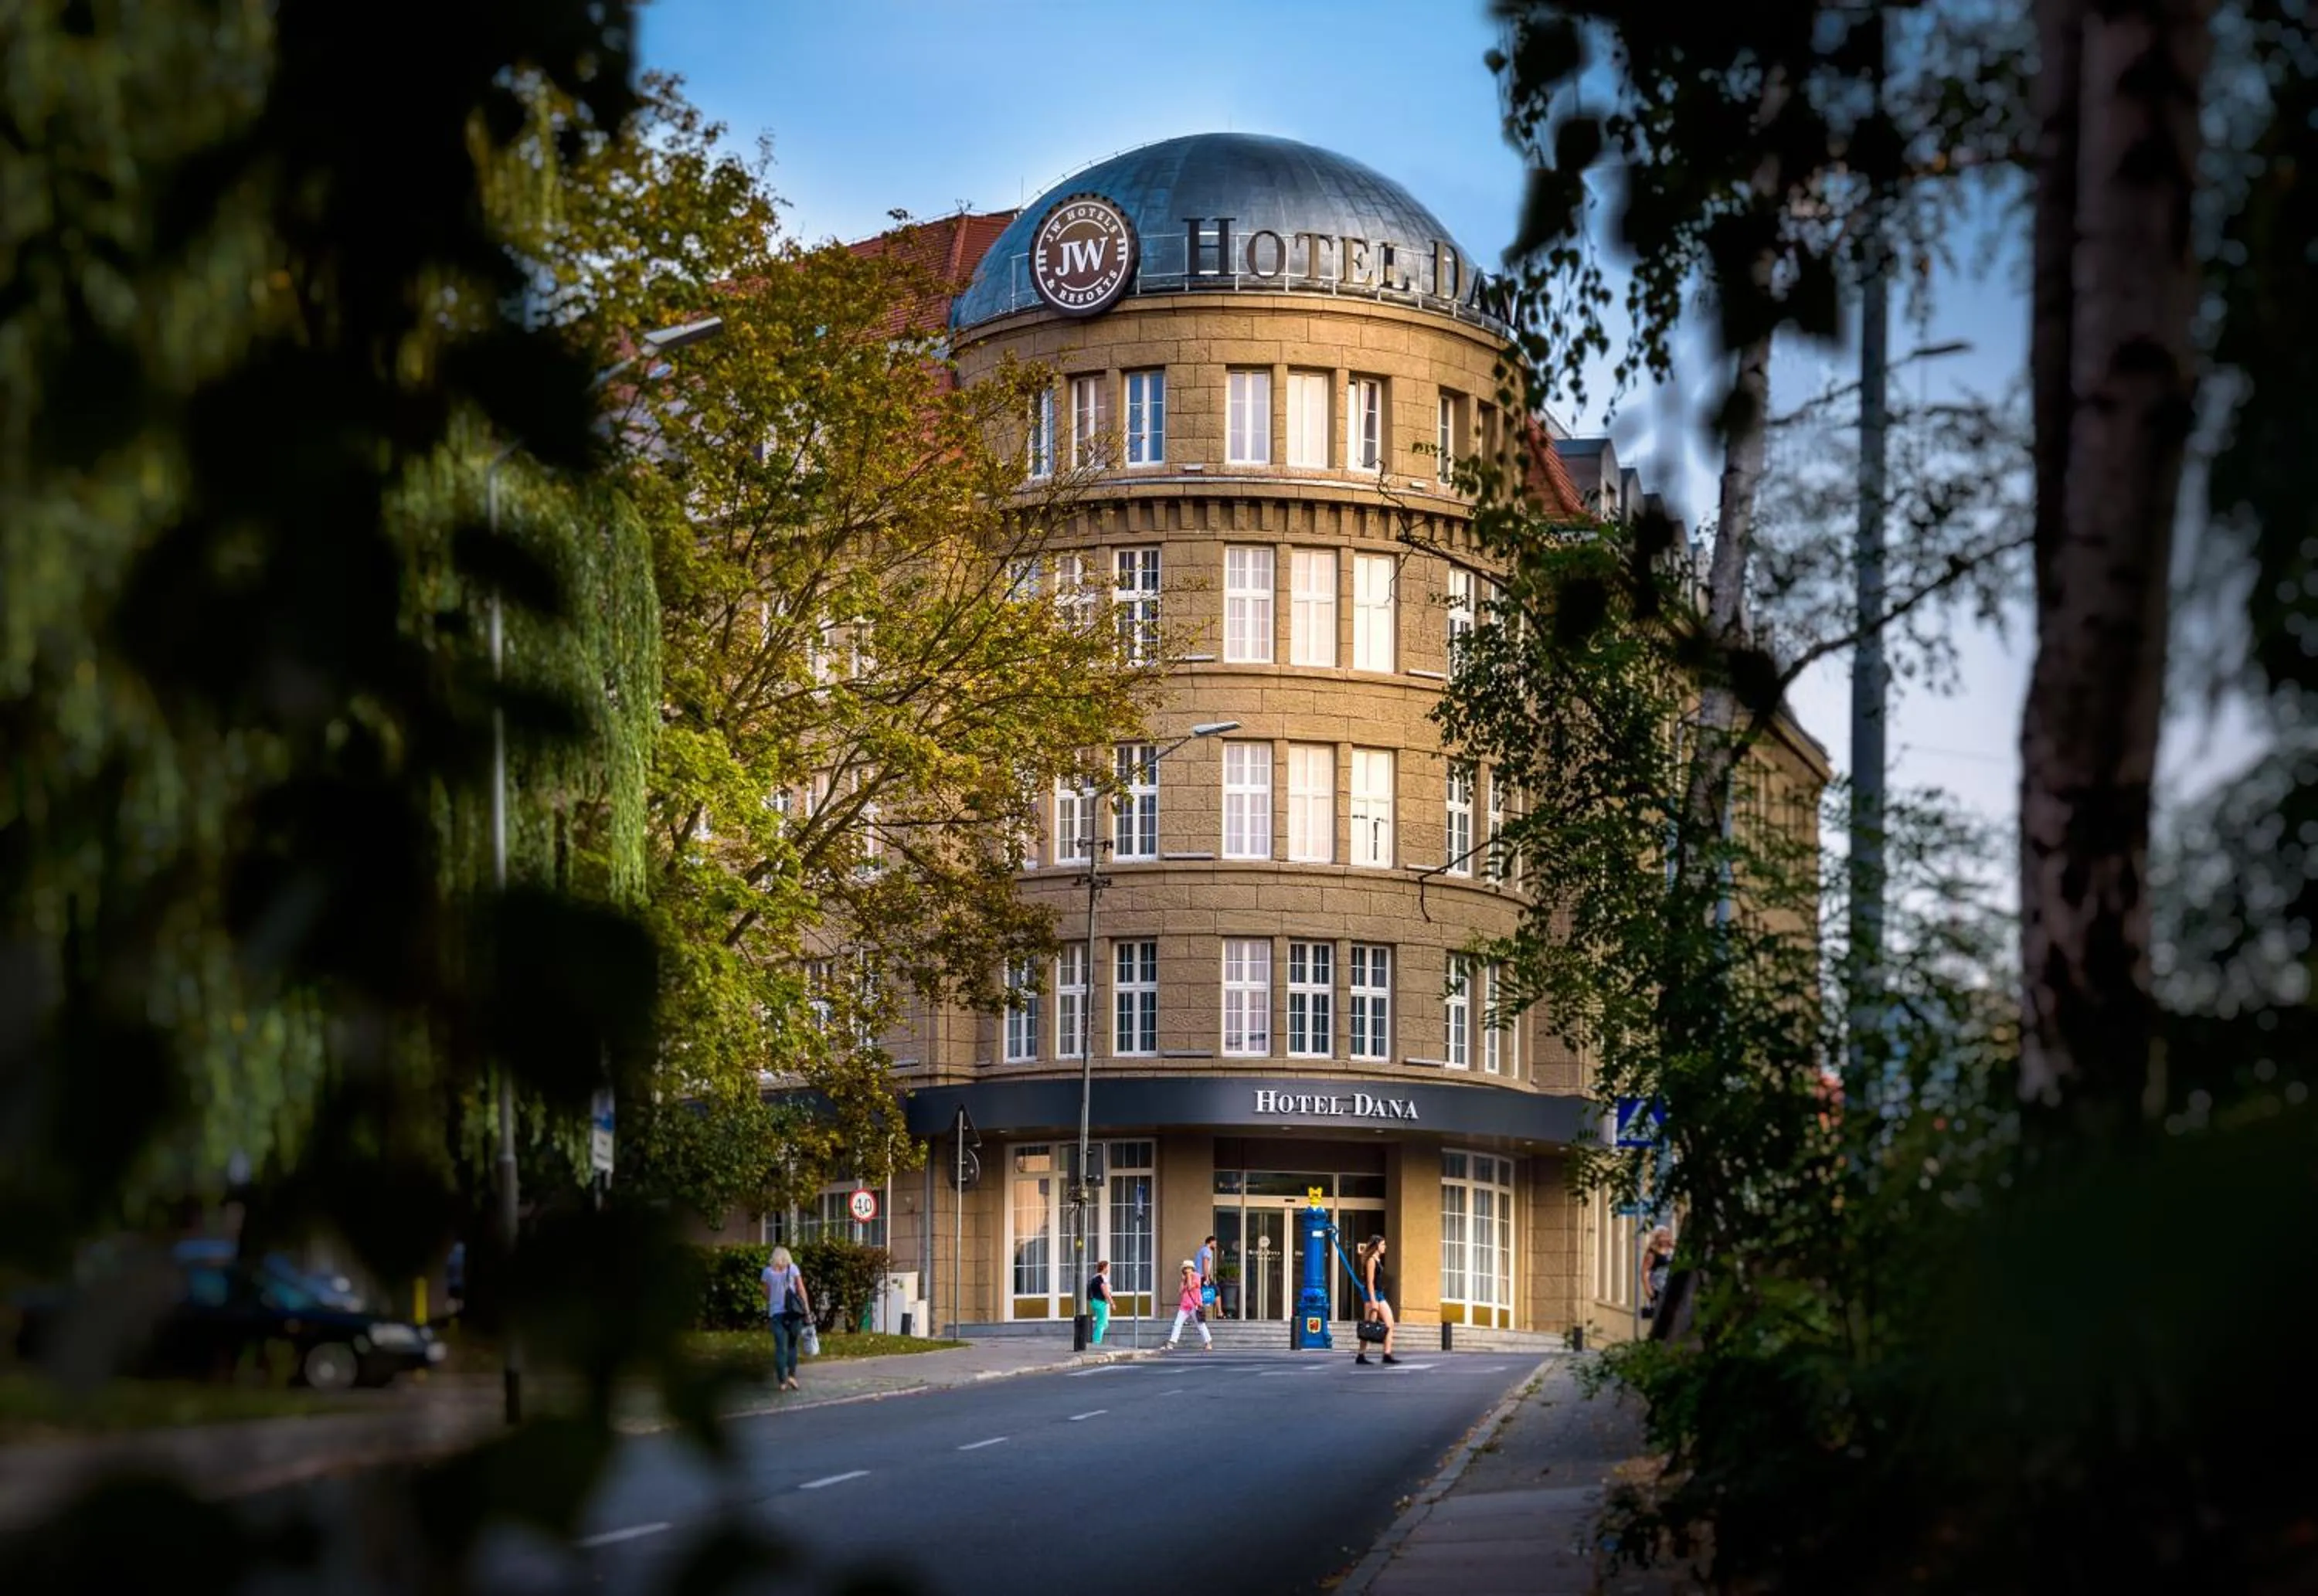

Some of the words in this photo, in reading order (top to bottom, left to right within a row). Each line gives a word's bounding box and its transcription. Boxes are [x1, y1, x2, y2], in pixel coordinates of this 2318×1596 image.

[1046, 220, 1062, 243] JW
[1066, 206, 1119, 233] HOTELS
[1055, 236, 1109, 277] JW
[1181, 217, 1410, 291] HOTEL
[1059, 270, 1118, 304] RESORTS
[1255, 1089, 1344, 1116] HOTEL
[1353, 1092, 1419, 1120] DANA
[854, 1198, 872, 1212] 40
